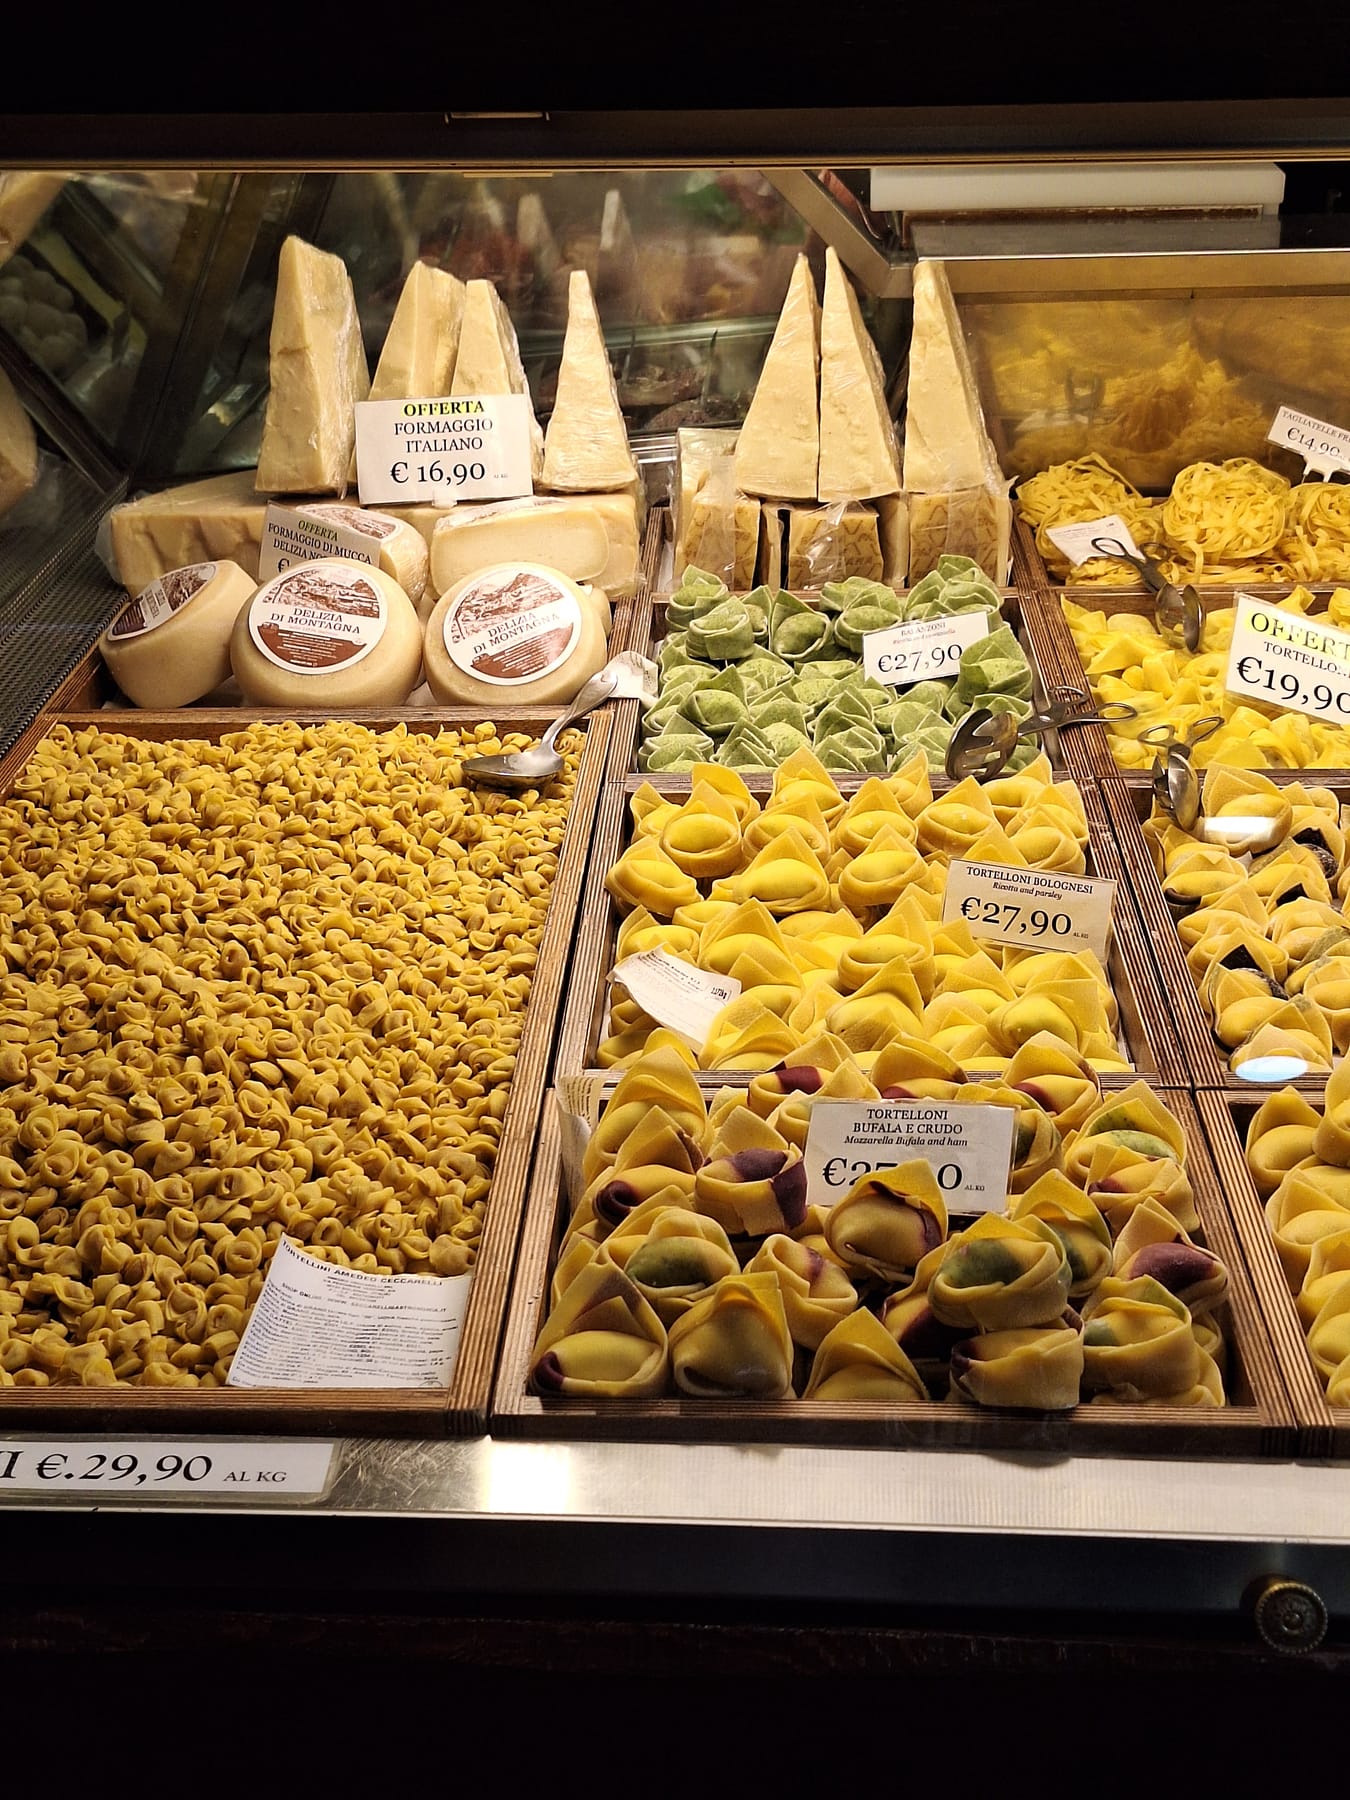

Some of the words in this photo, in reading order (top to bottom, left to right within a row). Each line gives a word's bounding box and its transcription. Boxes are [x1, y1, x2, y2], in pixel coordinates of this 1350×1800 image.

[403, 401, 485, 417] OFFERTA
[394, 419, 493, 436] FORMAGGIO
[1282, 411, 1338, 438] TAGLIATELLE
[406, 437, 483, 453] ITALIANO
[417, 460, 485, 486] 16,90
[298, 520, 338, 542] OFFERTA
[268, 523, 321, 549] FORMAGGIO
[323, 541, 333, 554] DI
[334, 546, 372, 565] MUCCA
[273, 538, 307, 559] DELIZIA
[271, 613, 284, 622] DI
[288, 616, 360, 634] MONTAGNA
[294, 608, 343, 622] DELIZIA
[488, 612, 536, 637] DELIZIA
[473, 643, 486, 654] DI
[489, 612, 560, 646] MONTAGNA
[878, 644, 963, 673] €27,90
[967, 866, 1031, 885] TORTELLONI
[1033, 877, 1093, 894] BOLOGNESI
[993, 882, 1019, 893] Ricotta
[1020, 886, 1034, 895] and
[1035, 889, 1063, 901] parsley
[960, 896, 1072, 937] €27,90
[867, 1108, 948, 1120] TORTELLONI
[853, 1122, 902, 1134] BUFALA
[906, 1123, 914, 1134] E
[917, 1124, 963, 1135] CRUDO
[844, 1135, 894, 1145] Mozzarella
[895, 1136, 926, 1147] Bufala
[927, 1136, 945, 1146] and
[947, 1136, 968, 1147] ham
[283, 1240, 331, 1272] TORTELLINI
[334, 1269, 377, 1282] AMEDEO
[381, 1277, 443, 1287] CECCARELLI
[36, 1453, 213, 1486] €.29,90
[223, 1471, 251, 1482] AL
[256, 1471, 288, 1483] KG
